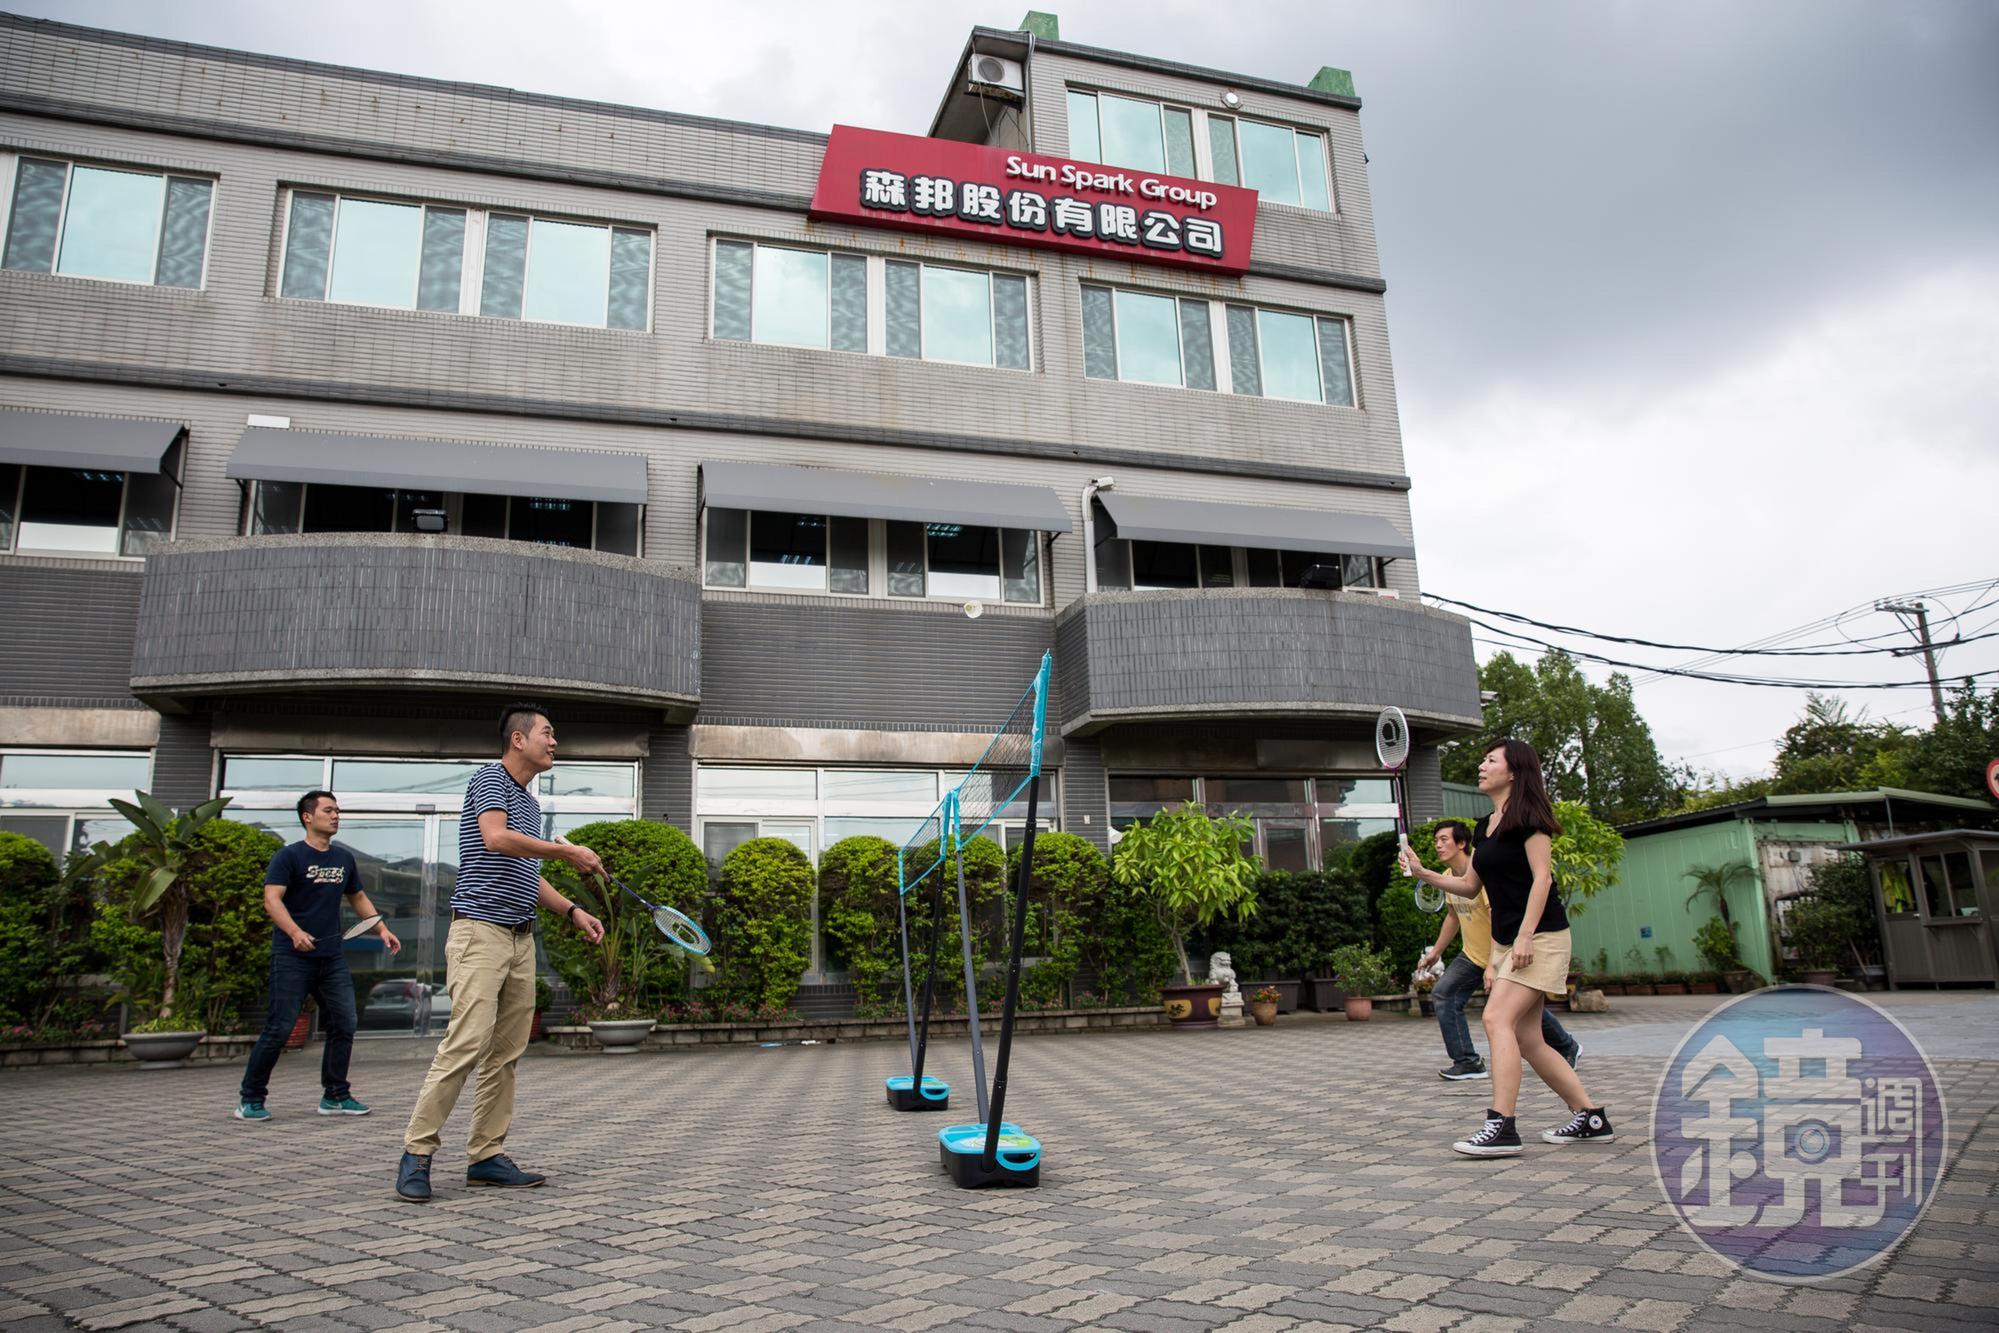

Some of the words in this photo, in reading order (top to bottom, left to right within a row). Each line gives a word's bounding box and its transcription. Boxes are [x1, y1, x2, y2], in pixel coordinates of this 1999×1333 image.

[864, 170, 1223, 254] 森邦股份有限公司
[1006, 156, 1057, 183] Sun
[1061, 165, 1134, 193] Spark
[1140, 179, 1217, 208] Group
